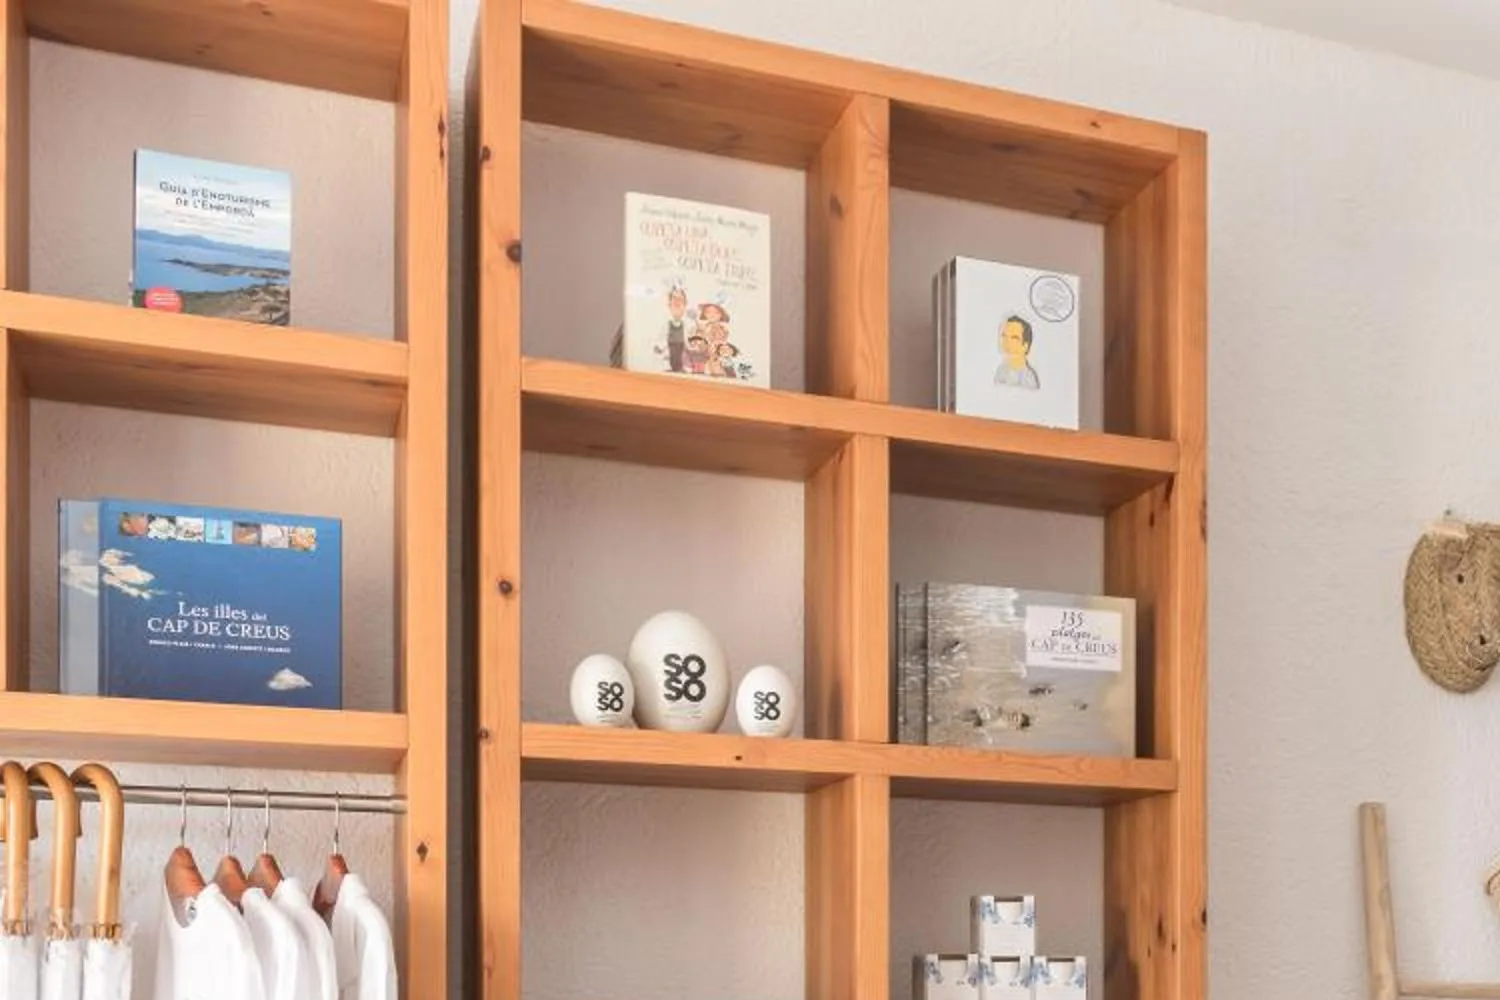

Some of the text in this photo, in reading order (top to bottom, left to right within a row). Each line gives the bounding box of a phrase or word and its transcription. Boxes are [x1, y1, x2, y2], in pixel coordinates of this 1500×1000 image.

[177, 601, 210, 618] Les
[214, 602, 249, 621] illes
[147, 617, 292, 641] CAP DE CREUS
[663, 653, 707, 677] SO
[597, 681, 625, 697] SO
[663, 677, 707, 702] SO
[753, 690, 781, 706] SO
[597, 696, 625, 712] SO
[753, 705, 781, 721] SO
